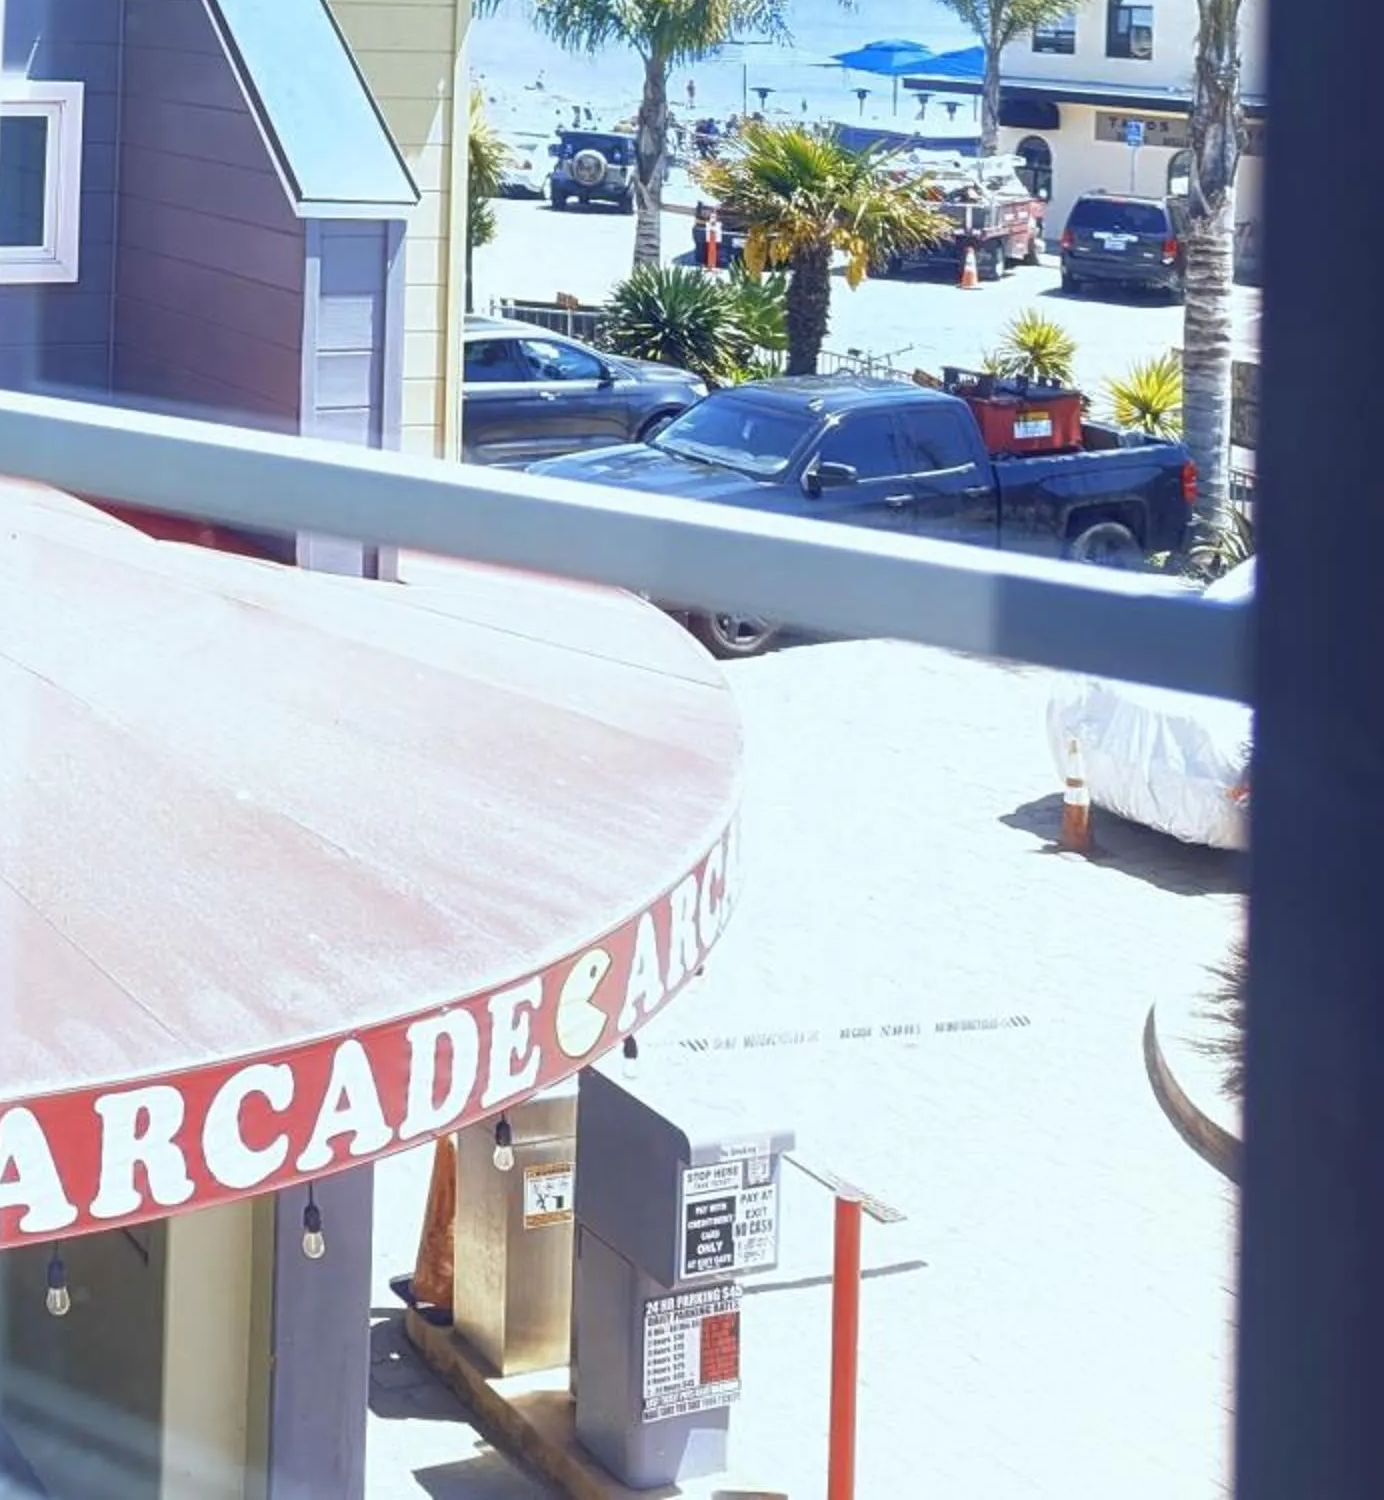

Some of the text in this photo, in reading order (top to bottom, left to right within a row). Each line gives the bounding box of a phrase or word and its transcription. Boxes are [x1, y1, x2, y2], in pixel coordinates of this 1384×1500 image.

[687, 1170, 712, 1183] STOP
[714, 1165, 738, 1178] HERE
[740, 1189, 773, 1203] PAY AT
[736, 1222, 747, 1237] NO
[697, 1240, 723, 1254] ONLY
[677, 1288, 721, 1308] PARKING
